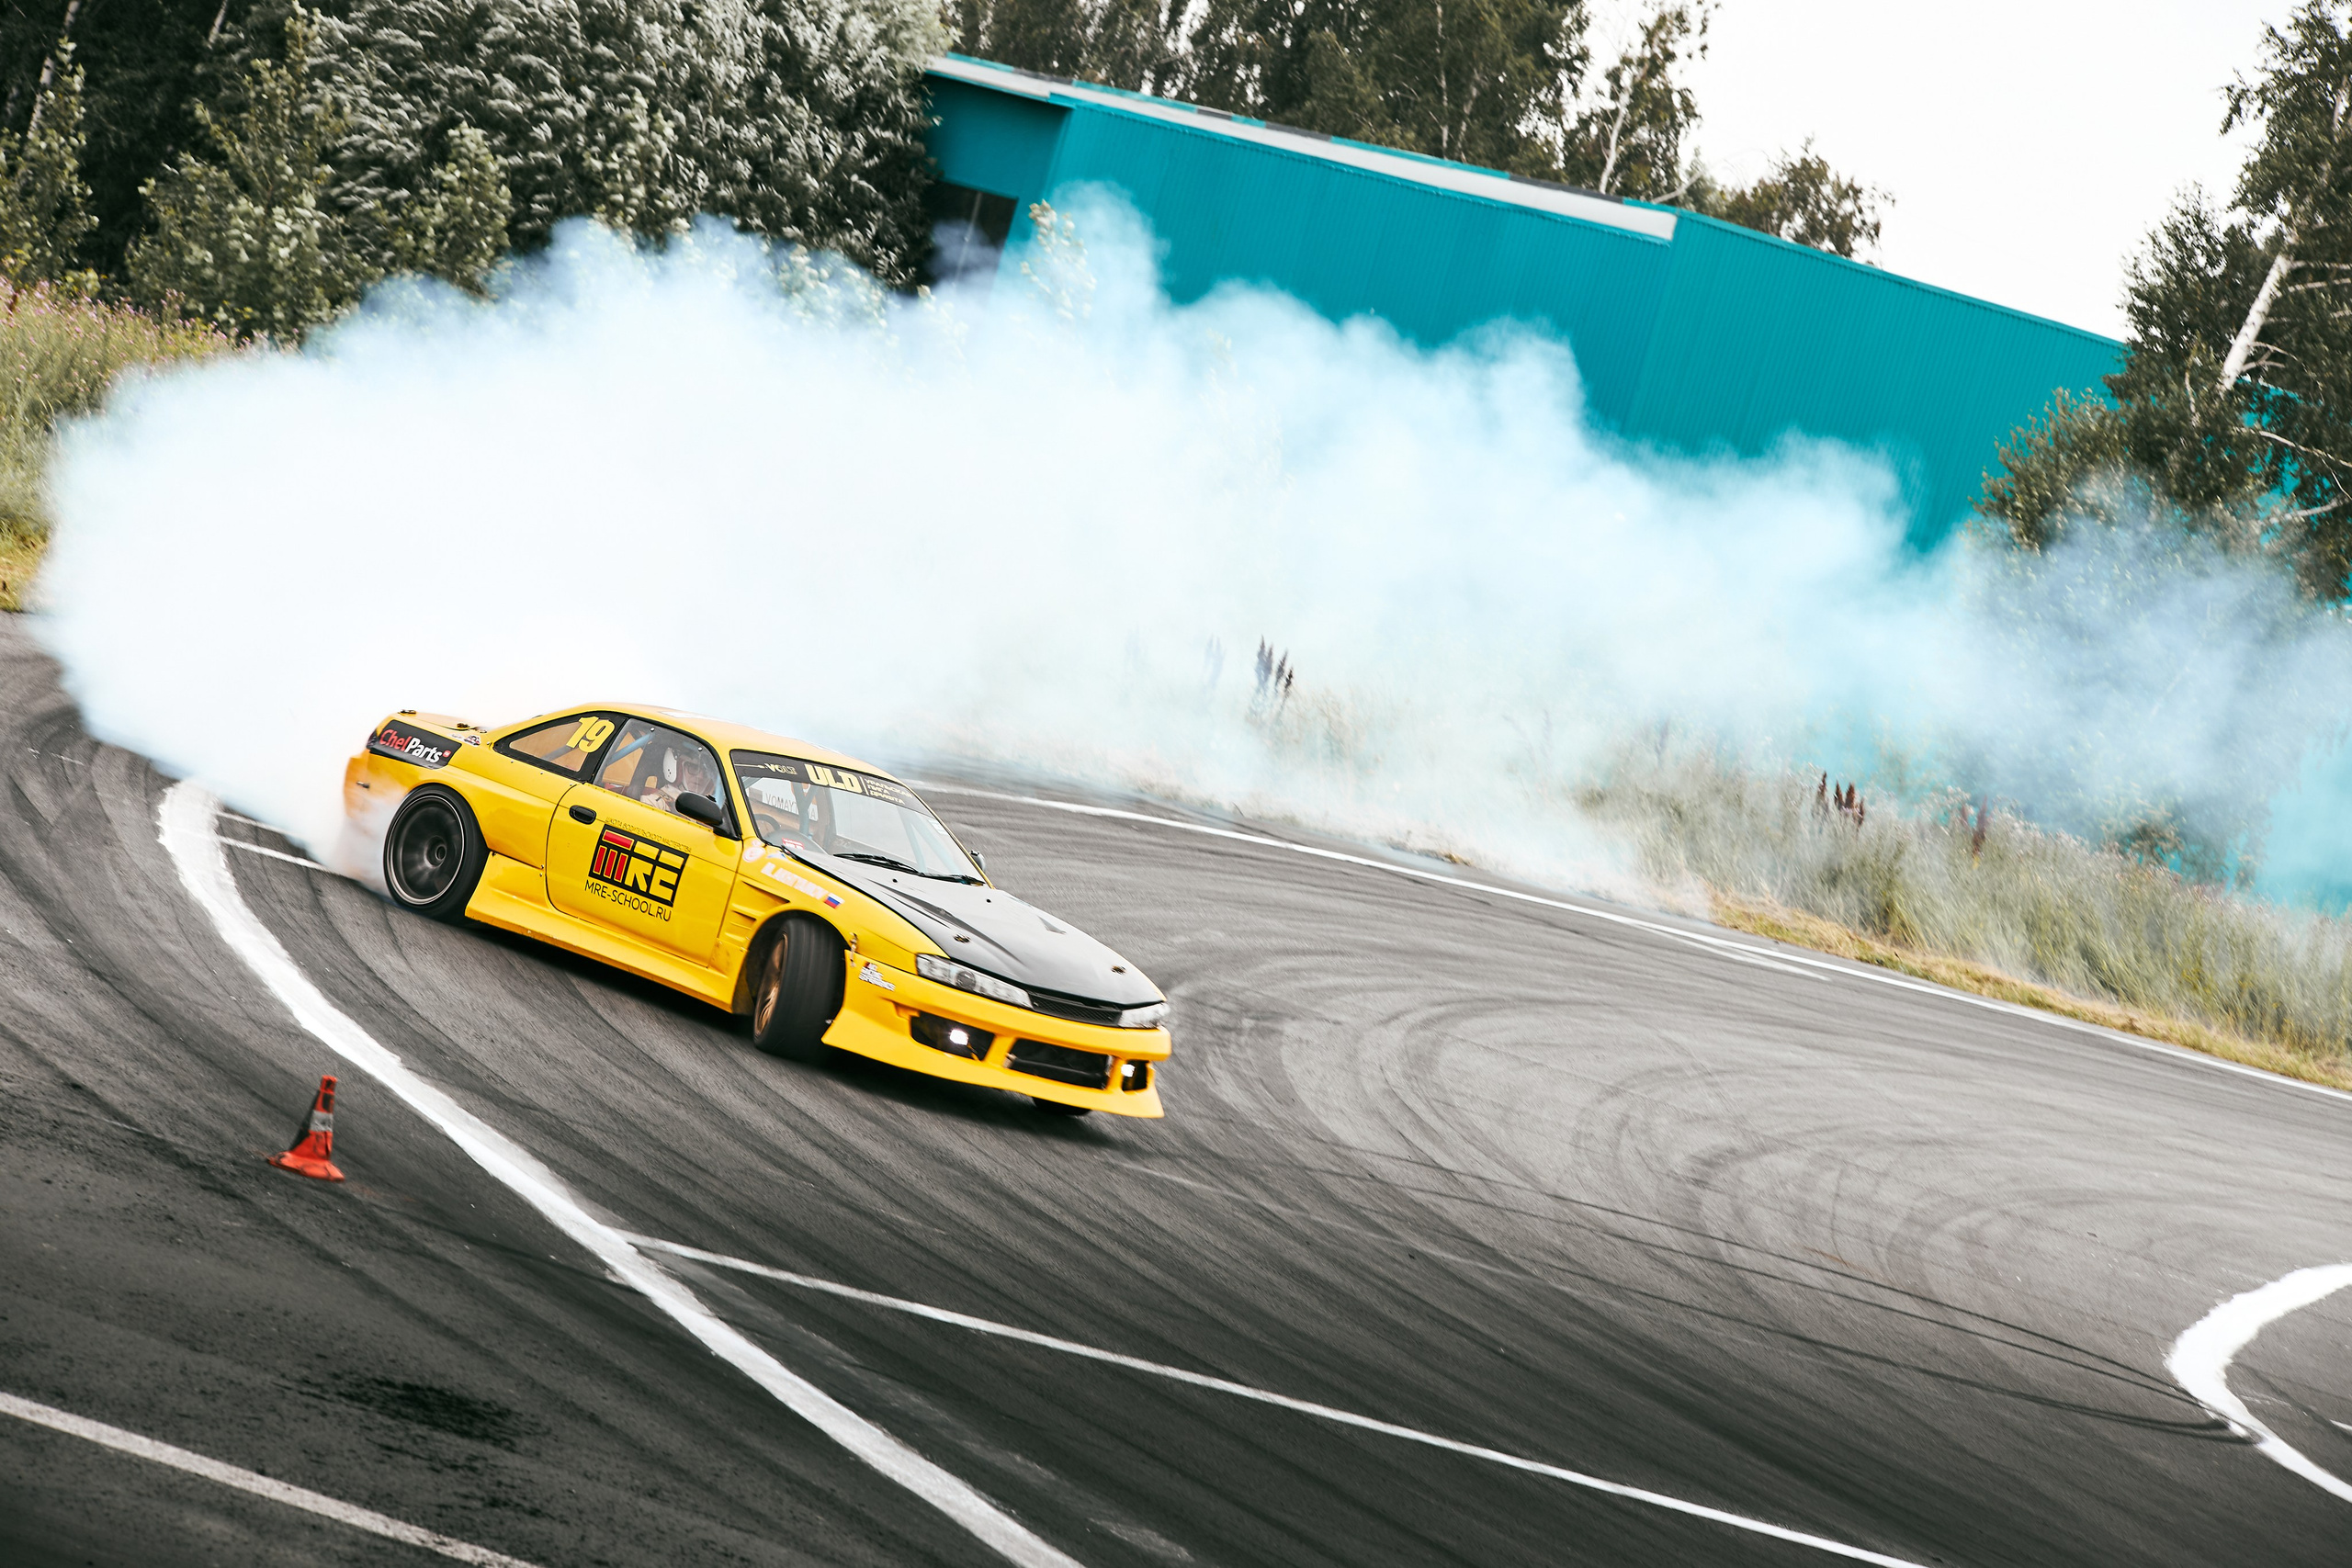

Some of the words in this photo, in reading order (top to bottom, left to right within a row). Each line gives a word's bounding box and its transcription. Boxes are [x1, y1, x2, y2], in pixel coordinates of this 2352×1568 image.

[379, 728, 443, 763] ChelParts
[566, 716, 615, 753] 19
[804, 763, 863, 794] ULD
[589, 825, 688, 908] MRE
[584, 879, 672, 922] MRE-SCHOOL.RU
